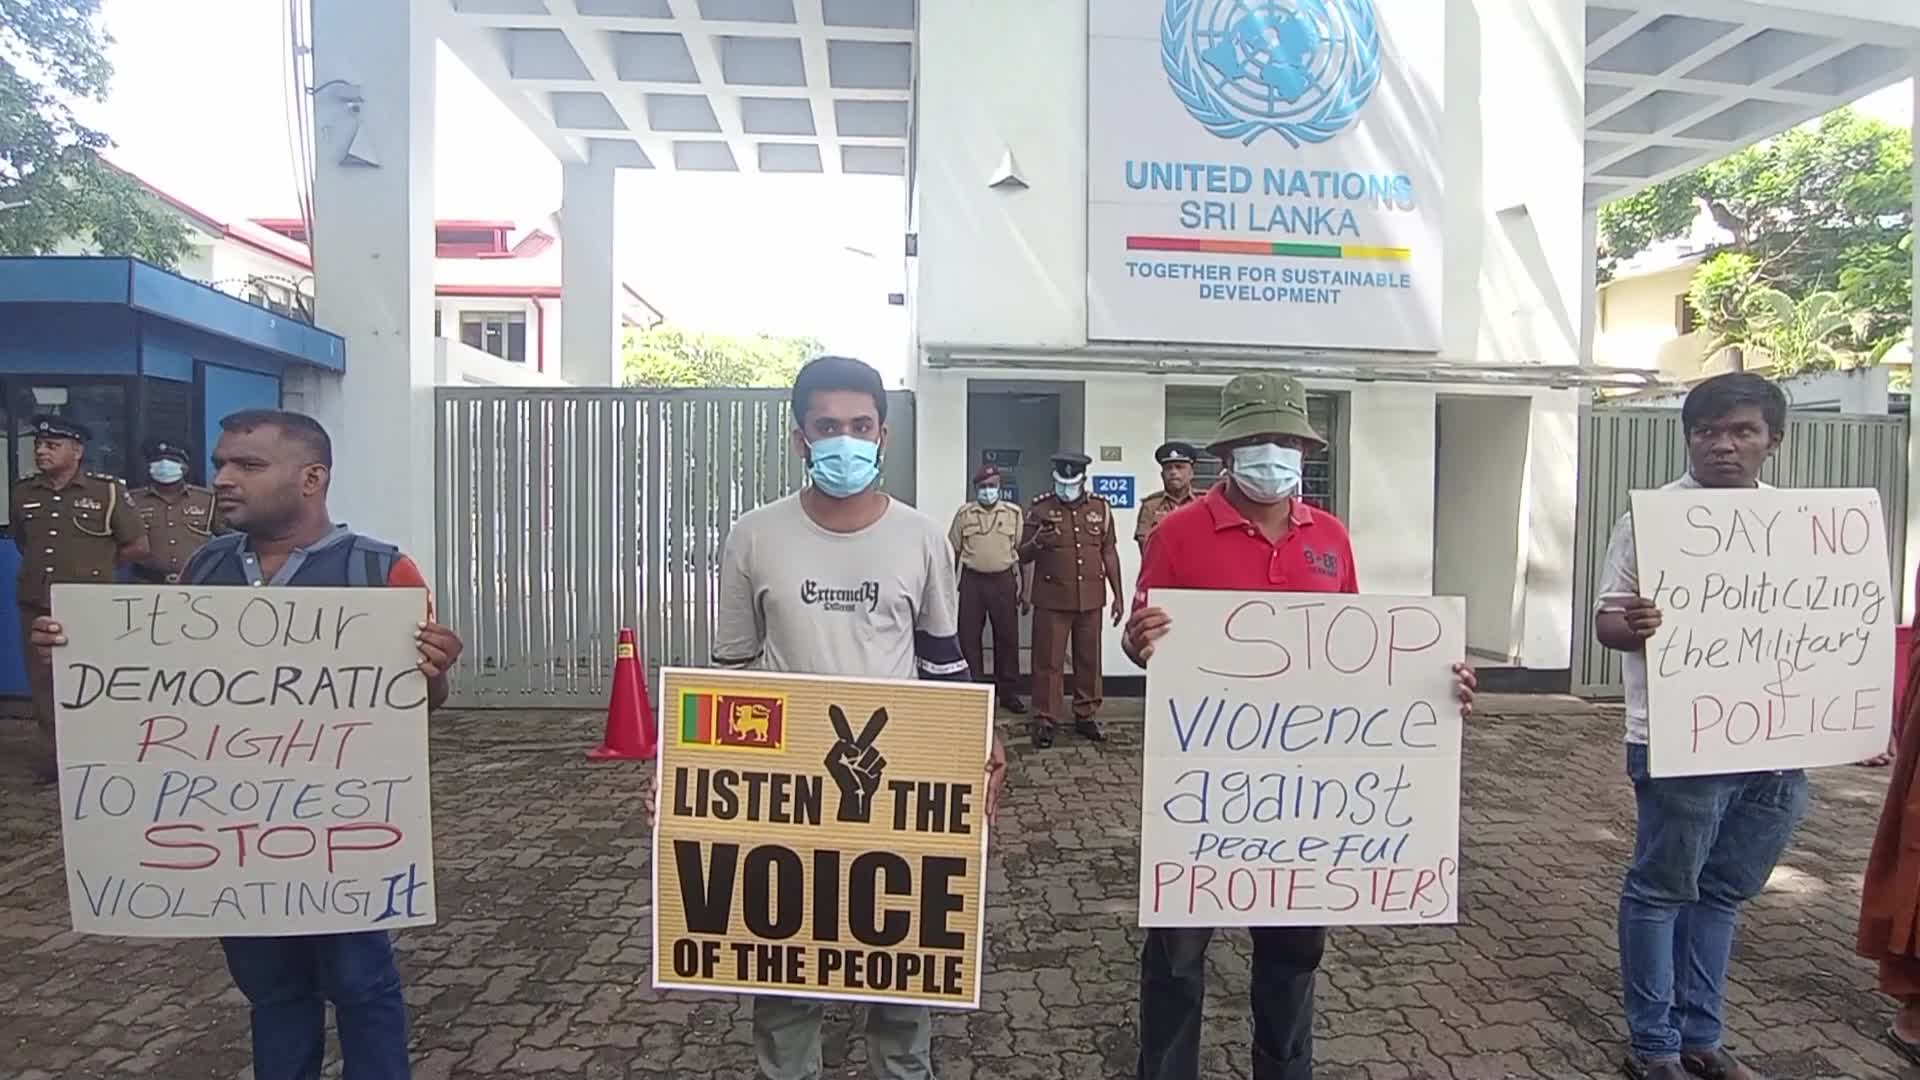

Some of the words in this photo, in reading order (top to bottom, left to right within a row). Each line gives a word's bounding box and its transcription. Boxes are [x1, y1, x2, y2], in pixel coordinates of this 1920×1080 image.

[1125, 160, 1253, 195] UNITED
[1263, 168, 1413, 201] NATIONS
[1180, 201, 1236, 231] SRI
[1249, 203, 1360, 237] LANKA
[1126, 262, 1230, 281] TOGETHER
[1237, 267, 1275, 284] FOR
[1282, 269, 1411, 289] SUSTAINABLE
[1199, 284, 1341, 304] DEVELOPMENT
[1100, 479, 1128, 491] 202
[1103, 494, 1128, 506] 04
[1680, 505, 1781, 557] SAY
[1654, 570, 1690, 610] to
[1198, 600, 1442, 686] STOP
[1658, 625, 1729, 678] the
[61, 663, 427, 710] DEMOCRATIC
[137, 715, 373, 769] RIGHT
[1691, 688, 1881, 753] POLICE
[66, 764, 136, 820] TO
[153, 771, 413, 822] PROTEST
[673, 767, 823, 825] LISTEN
[888, 780, 972, 834] THE
[1163, 764, 1413, 828] against
[139, 824, 403, 873] STOP
[76, 869, 371, 920] VIOLATING
[371, 864, 428, 923] It
[673, 839, 967, 950] VOICE
[1153, 857, 1456, 918] PROTESTERS
[673, 938, 720, 979] OF
[731, 942, 806, 984] THE
[818, 947, 963, 995] PEOPLE
